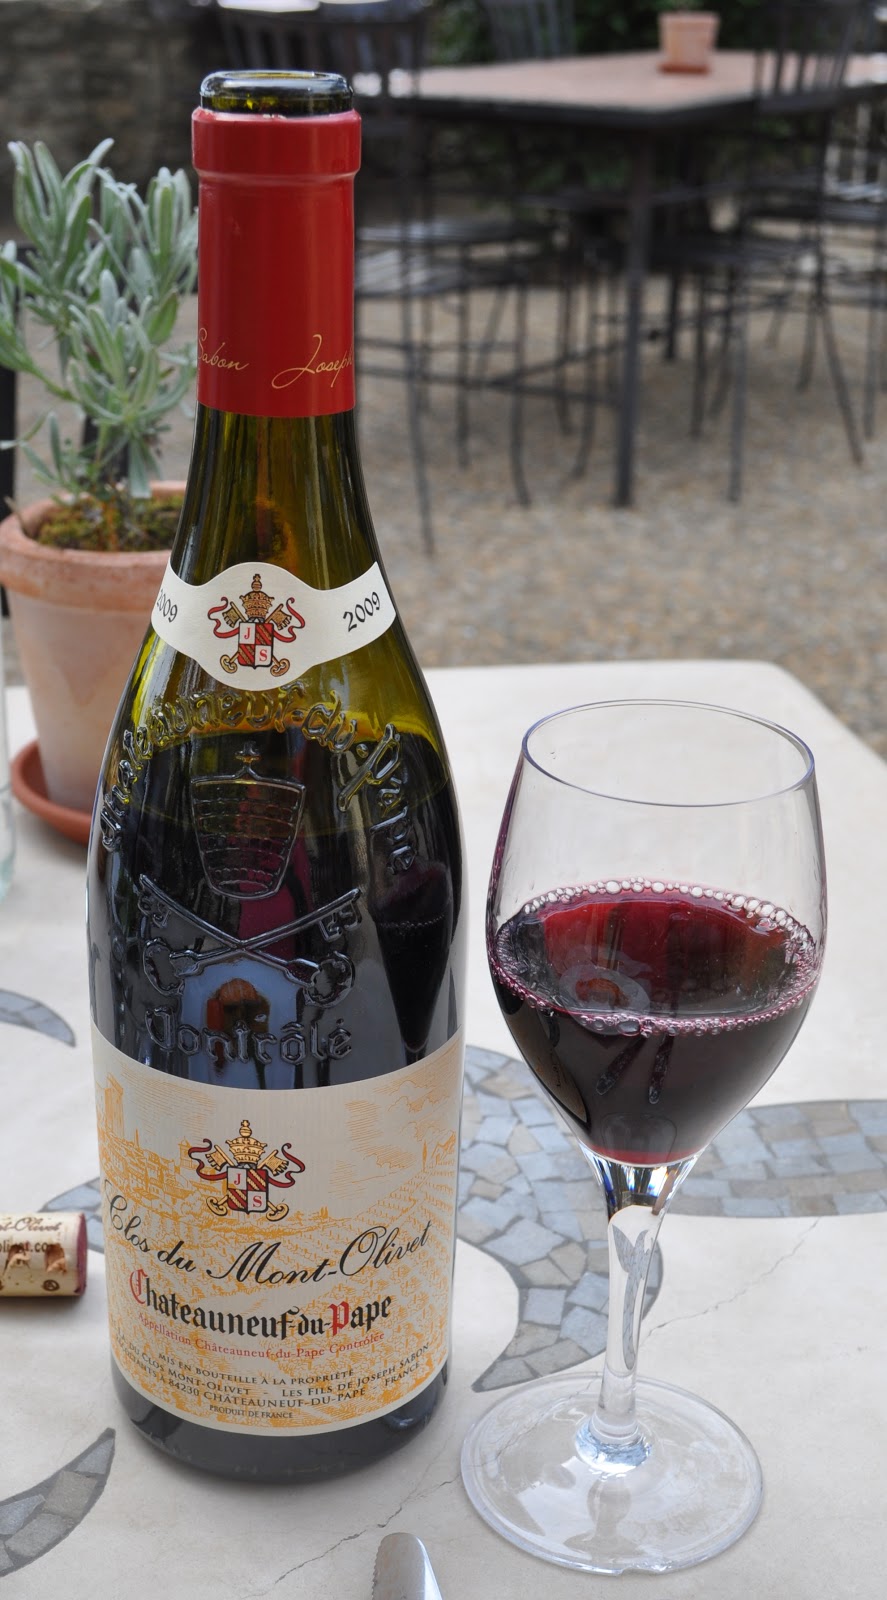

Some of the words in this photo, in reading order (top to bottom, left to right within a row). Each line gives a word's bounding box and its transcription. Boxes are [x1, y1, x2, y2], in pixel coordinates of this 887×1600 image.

[198, 327, 250, 371] Sabon
[271, 333, 353, 389] Joseph
[342, 591, 381, 632] 2009
[244, 627, 251, 640] J
[259, 648, 268, 662] S
[233, 1173, 241, 1186] J
[252, 1195, 263, 1208] S
[104, 1179, 150, 1253] Clos
[157, 1240, 196, 1273] du
[206, 1220, 432, 1285] Mont-Olivet
[139, 1312, 191, 1346] Appellation
[195, 1338, 325, 1360] Châteauneuf-du-Pape
[329, 1332, 385, 1354] Contrôlée
[142, 1353, 164, 1372] CLOS
[168, 1368, 250, 1396] MONT-OLIVET
[308, 1385, 332, 1396] FILS
[338, 1381, 353, 1392] DE
[357, 1366, 396, 1388] JOSEPH
[400, 1342, 430, 1368] SABON
[158, 1353, 175, 1366] MIS
[178, 1360, 192, 1372] EN
[196, 1367, 257, 1385] BOUTEILLE
[169, 1378, 199, 1397] 84230
[385, 1361, 420, 1387] FRANCE
[209, 1404, 245, 1417] PRODUIT
[248, 1410, 259, 1418] DE
[261, 1411, 293, 1420] FRANCE
